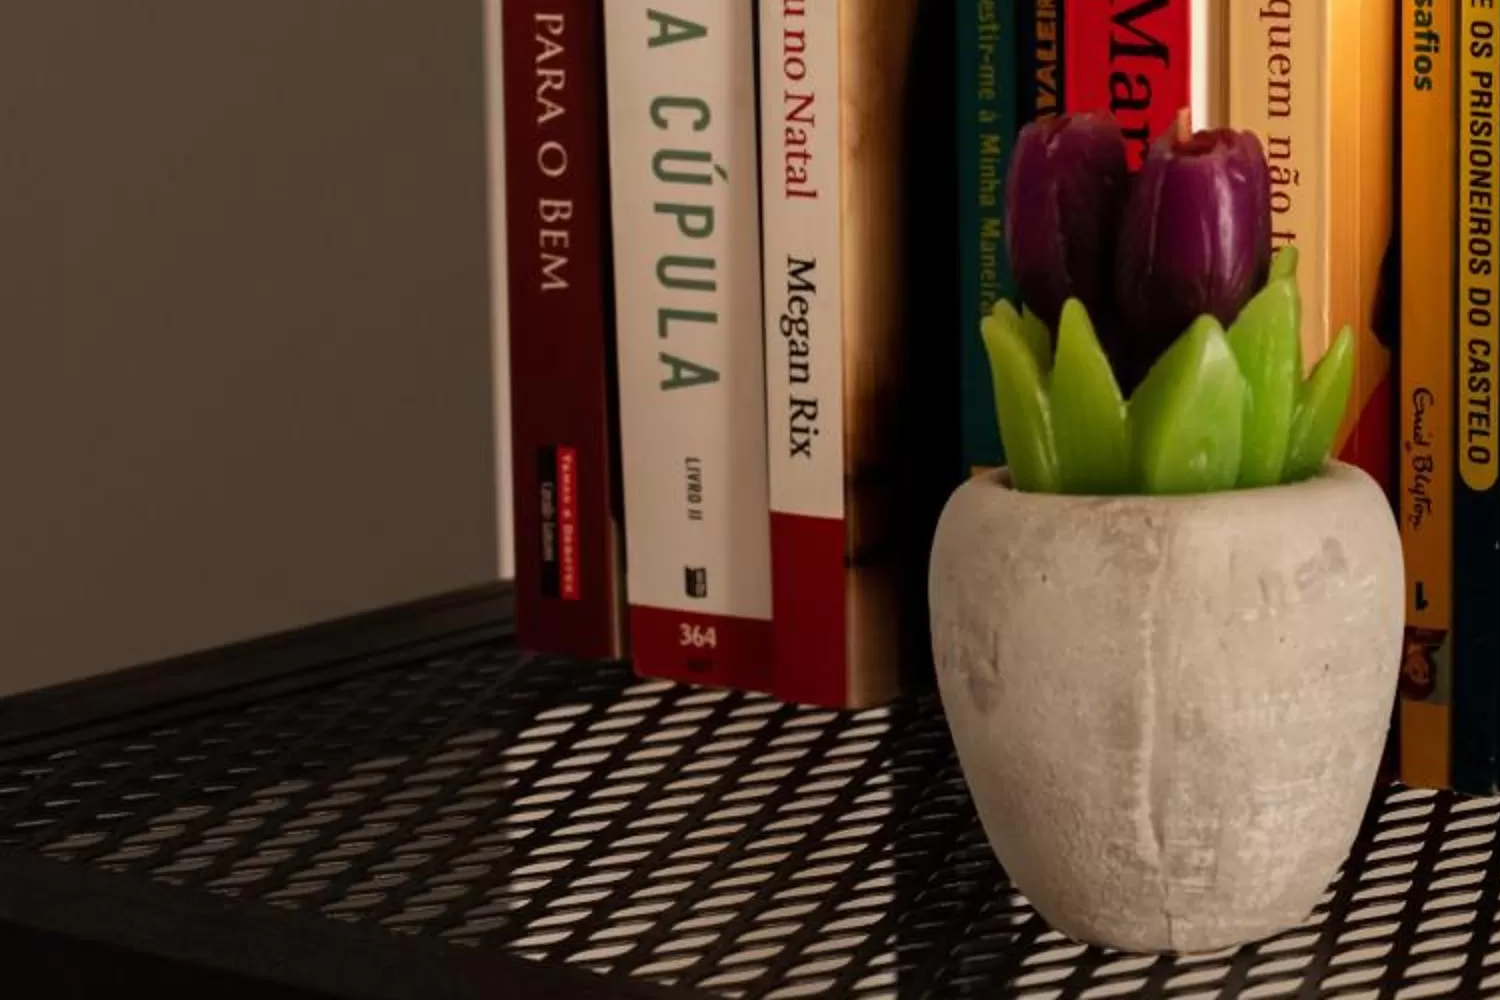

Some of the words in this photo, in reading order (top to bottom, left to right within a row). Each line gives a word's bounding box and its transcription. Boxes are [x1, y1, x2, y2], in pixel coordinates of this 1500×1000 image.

[647, 8, 707, 49] A
[783, 28, 806, 81] no
[1469, 21, 1494, 59] OS
[534, 12, 567, 126] PARA
[537, 141, 568, 178] O
[783, 90, 818, 200] Natal
[978, 133, 1001, 207] Minha
[1268, 136, 1300, 213] não
[1468, 70, 1494, 276] PRISIONEIROS
[539, 198, 573, 291] BEM
[650, 96, 728, 391] CÚPULA
[780, 257, 816, 384] Megan
[1467, 287, 1492, 327] DO
[789, 398, 819, 459] Rix
[1467, 339, 1491, 465] CASTELO
[684, 456, 703, 505] LIVRO
[687, 508, 703, 521] II
[679, 622, 717, 648] 364
